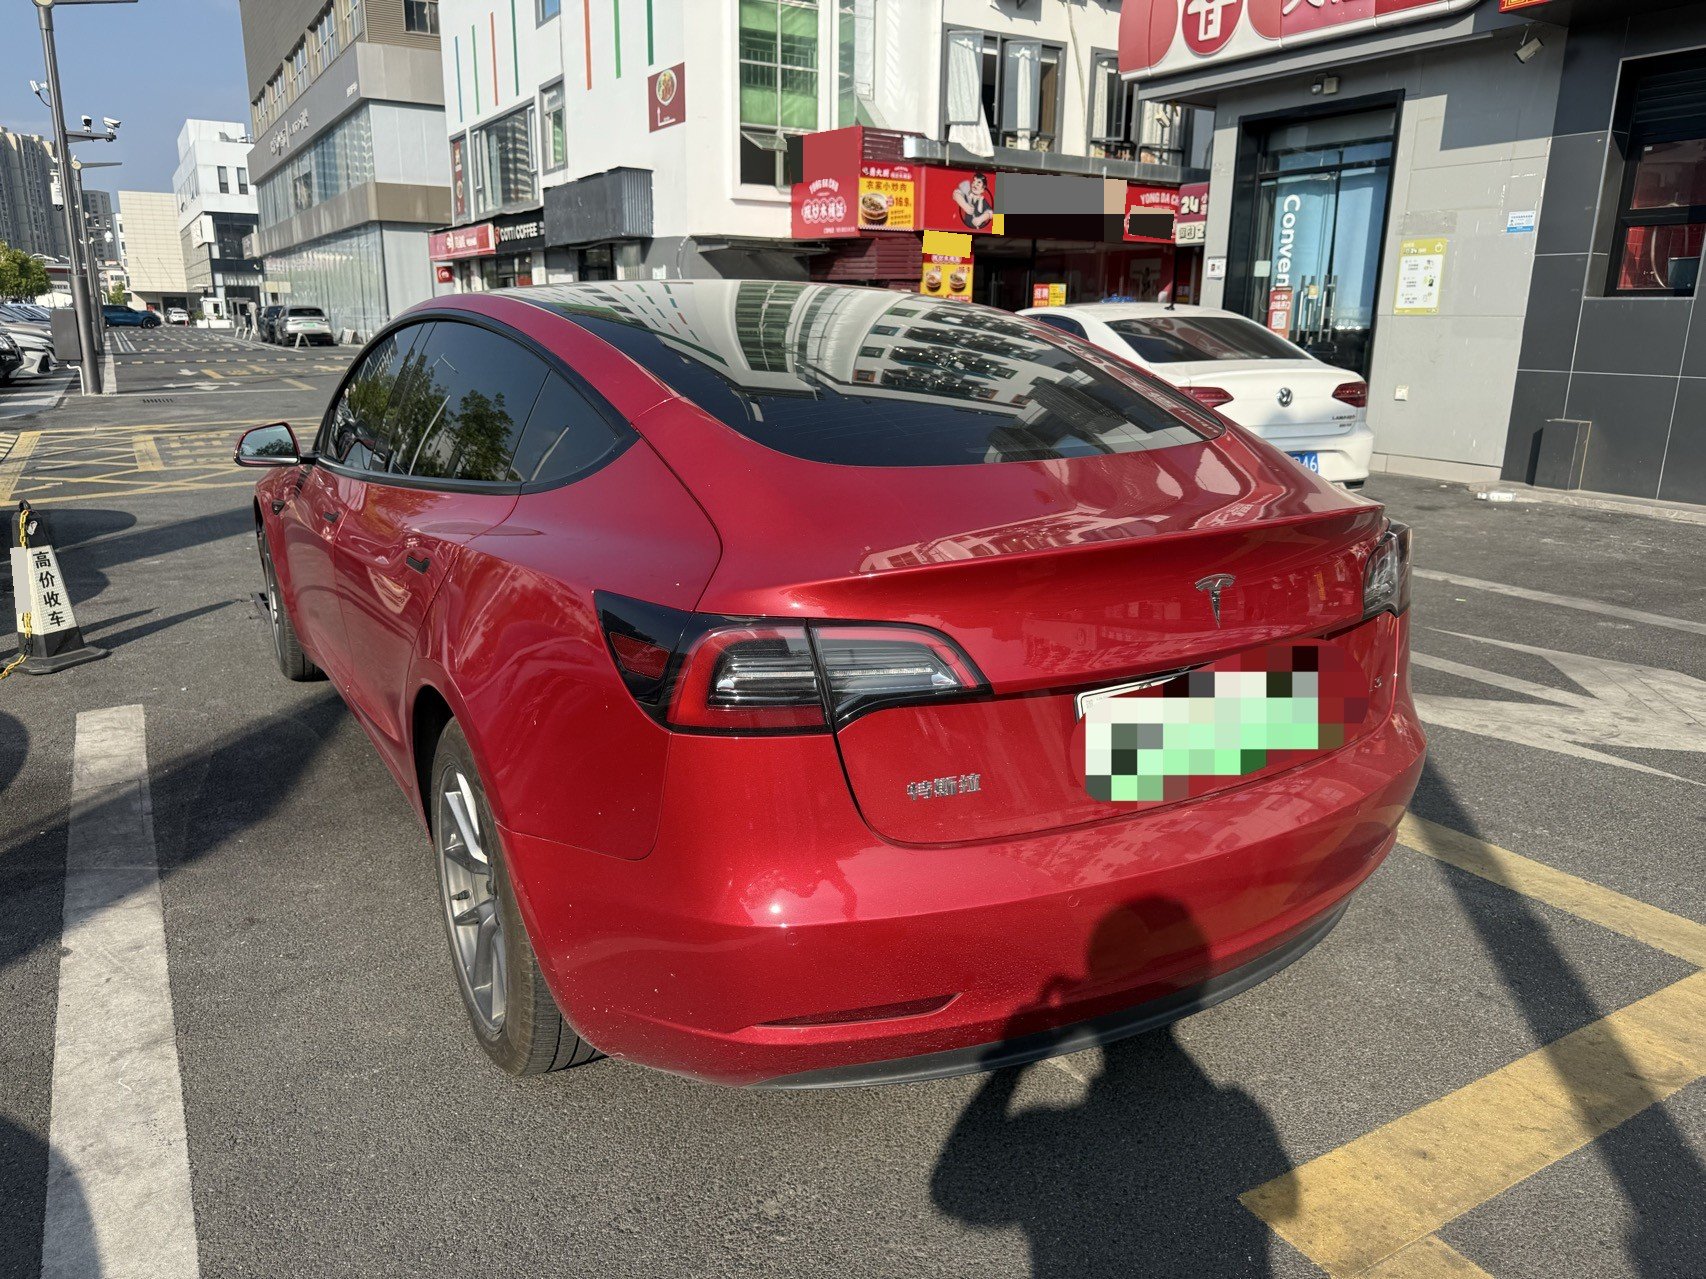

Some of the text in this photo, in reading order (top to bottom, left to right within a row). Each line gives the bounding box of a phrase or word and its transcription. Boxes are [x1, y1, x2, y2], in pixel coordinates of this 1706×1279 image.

[1181, 195, 1199, 214] 24
[515, 221, 538, 240] COFFEE
[1276, 194, 1301, 287] Conven
[33, 551, 65, 627] 高价收车
[907, 773, 981, 801] 特斯拉
